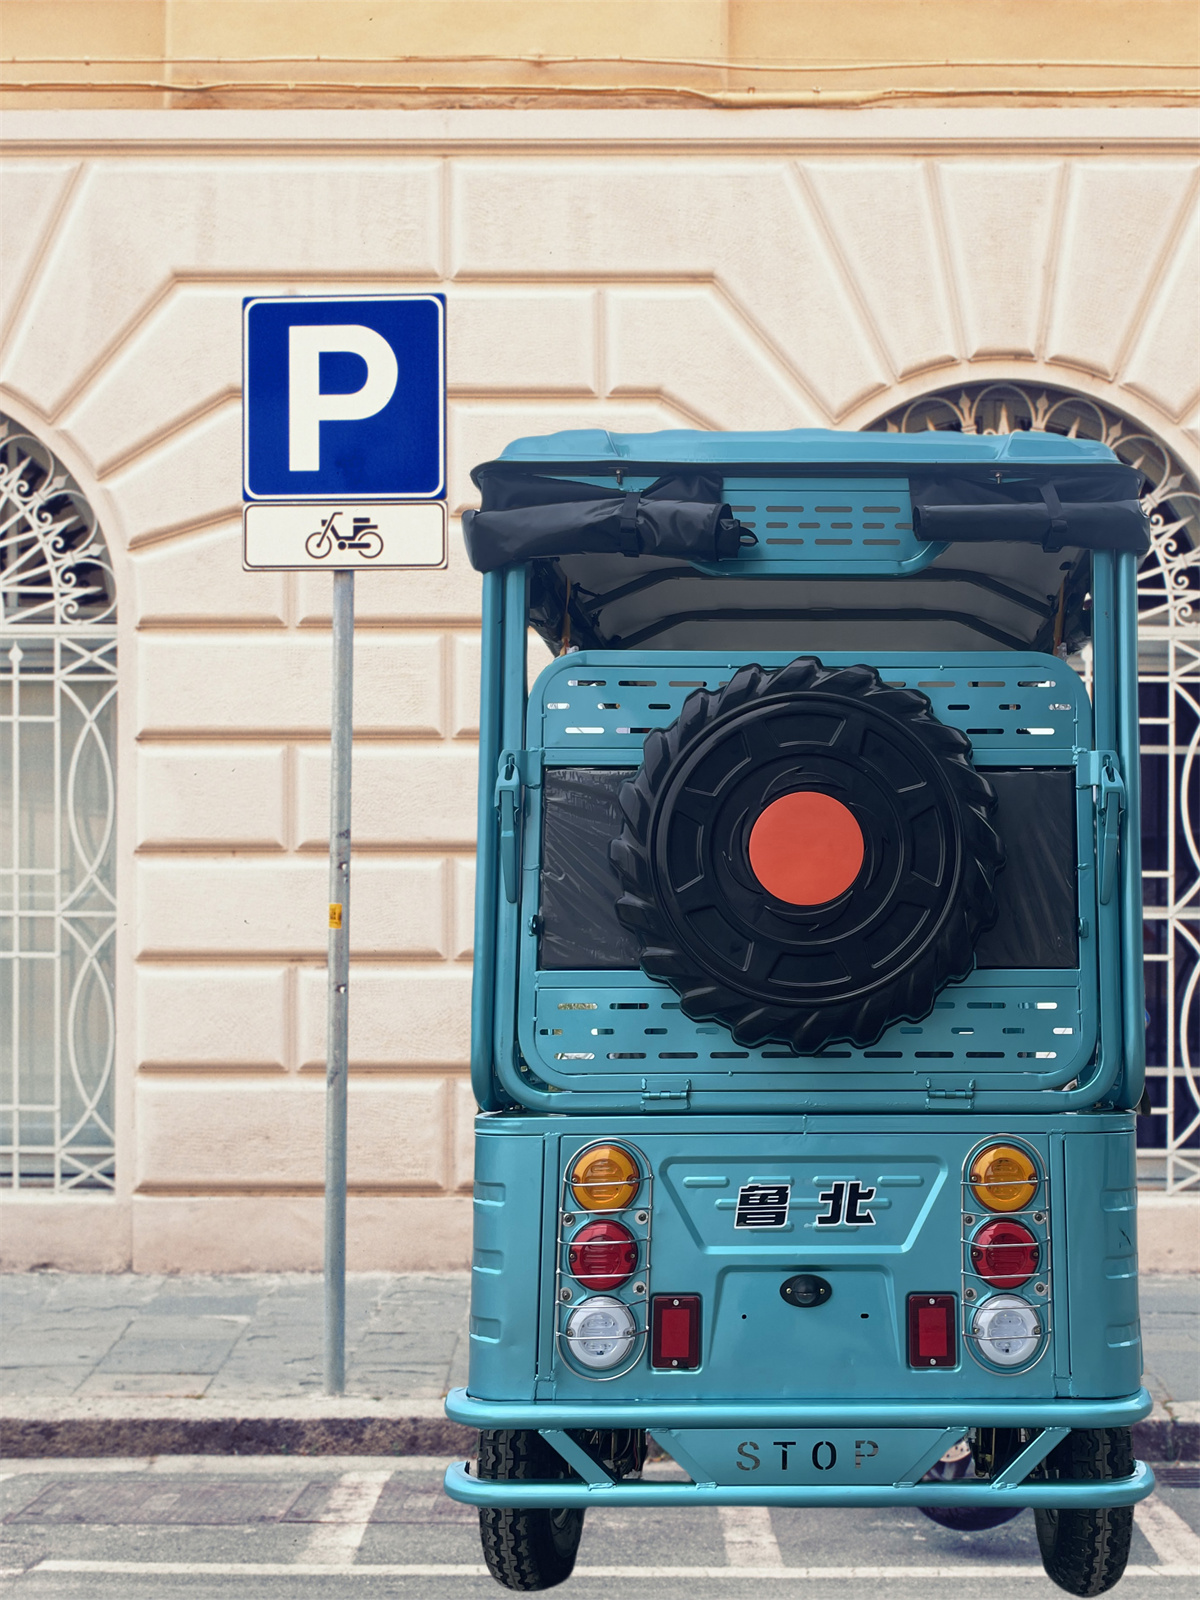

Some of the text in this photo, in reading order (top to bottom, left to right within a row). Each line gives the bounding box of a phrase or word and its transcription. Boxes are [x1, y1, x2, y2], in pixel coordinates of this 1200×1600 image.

[288, 324, 398, 471] P
[734, 1181, 876, 1229] 鲁北
[736, 1440, 879, 1471] STOP
